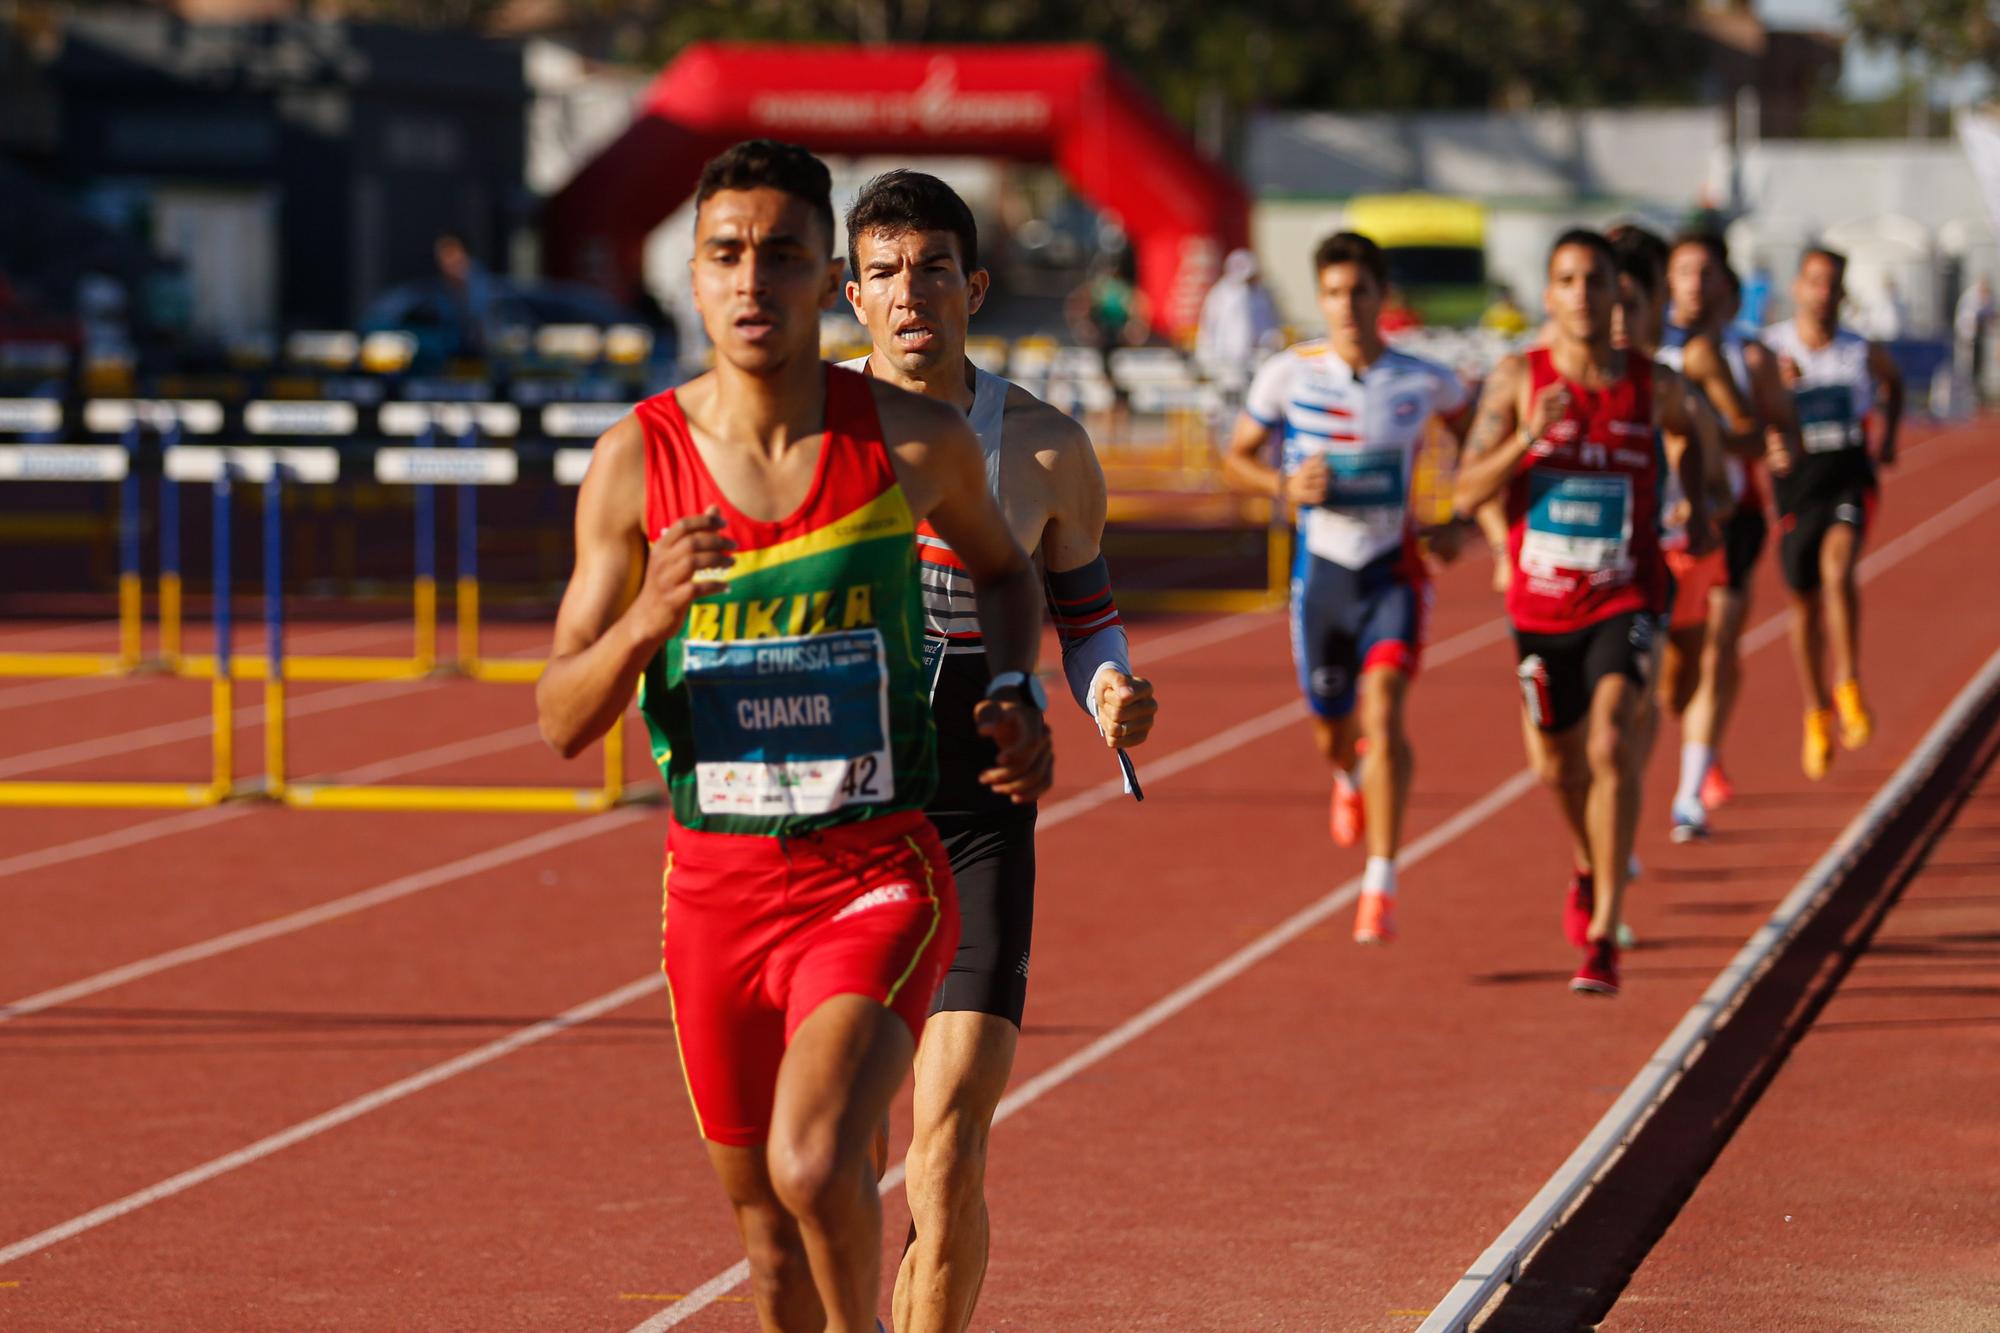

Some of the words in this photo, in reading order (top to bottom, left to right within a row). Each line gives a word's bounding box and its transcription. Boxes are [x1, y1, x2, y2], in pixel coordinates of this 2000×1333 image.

[689, 584, 872, 641] BIKILA
[756, 644, 831, 674] EIVISSA
[737, 693, 832, 731] CHAKIR
[840, 754, 879, 798] 42
